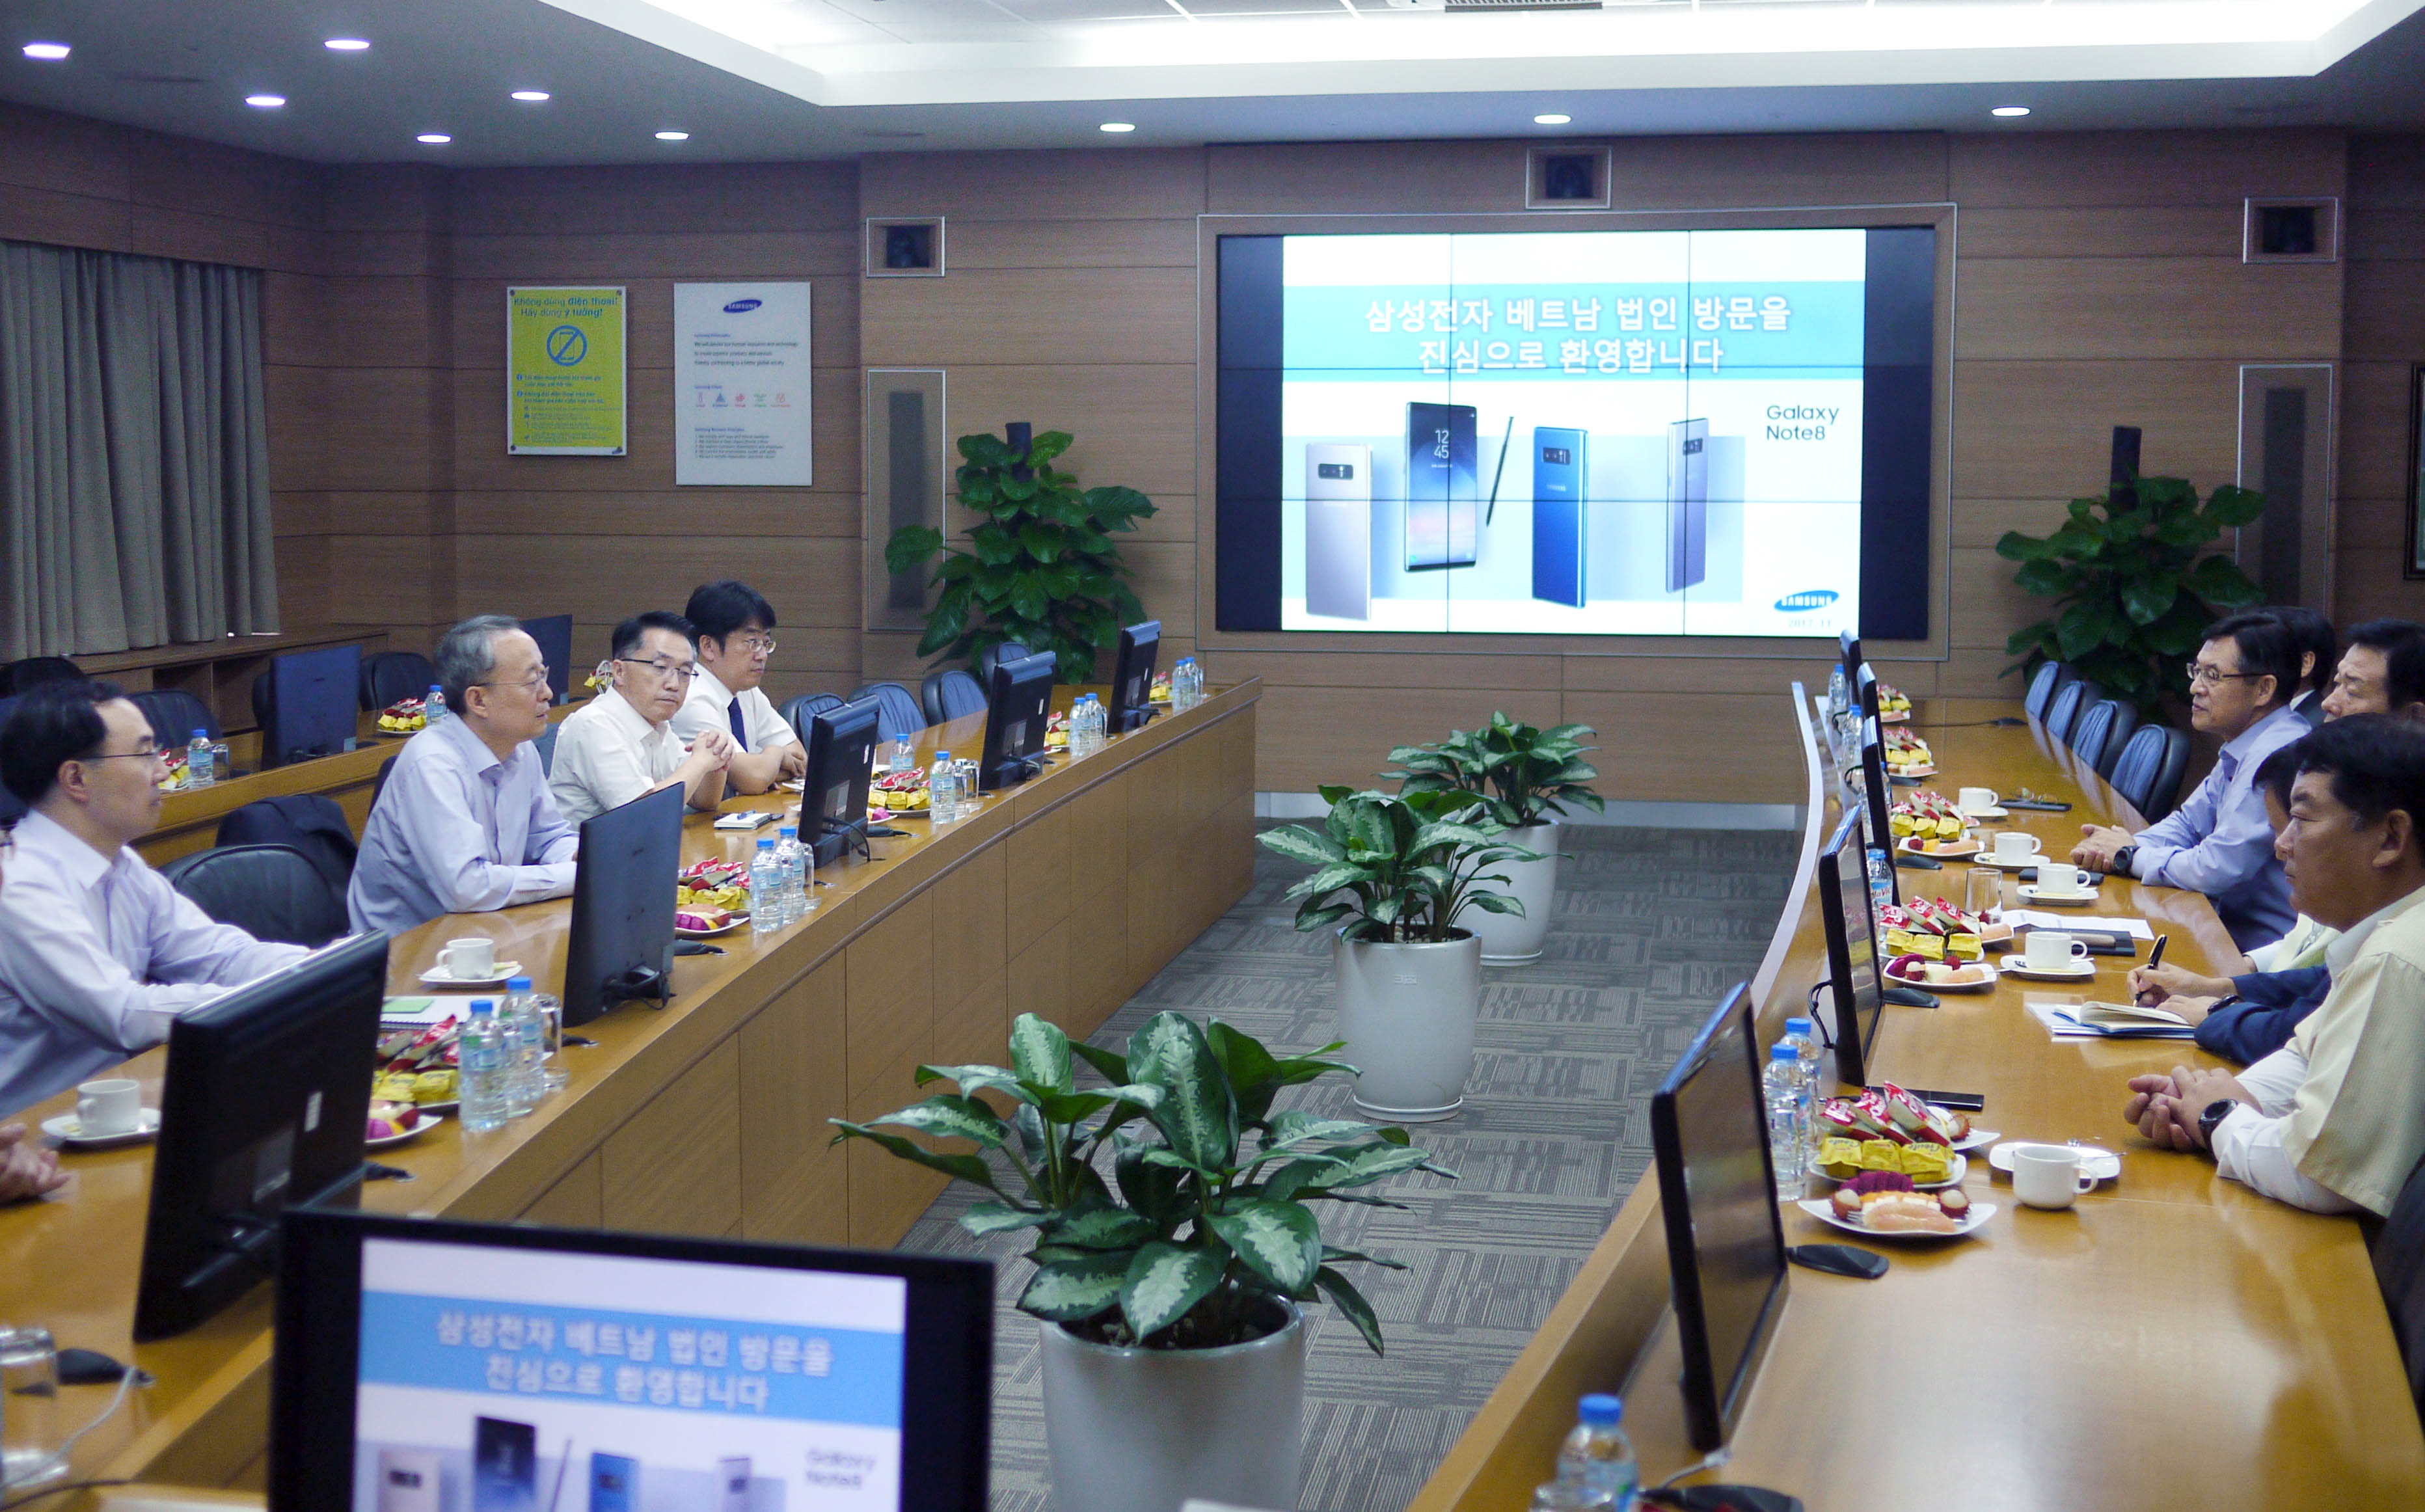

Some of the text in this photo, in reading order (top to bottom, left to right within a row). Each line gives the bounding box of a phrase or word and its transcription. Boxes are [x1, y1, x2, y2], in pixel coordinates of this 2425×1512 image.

[1364, 296, 1791, 332] 삼성전자 베트남 법인 방문을
[1418, 338, 1724, 374] 진심으로 환영합니다
[1767, 405, 1839, 425] Galaxy
[1435, 429, 1450, 444] 12
[1767, 425, 1826, 440] Note8
[1433, 444, 1450, 459] 45
